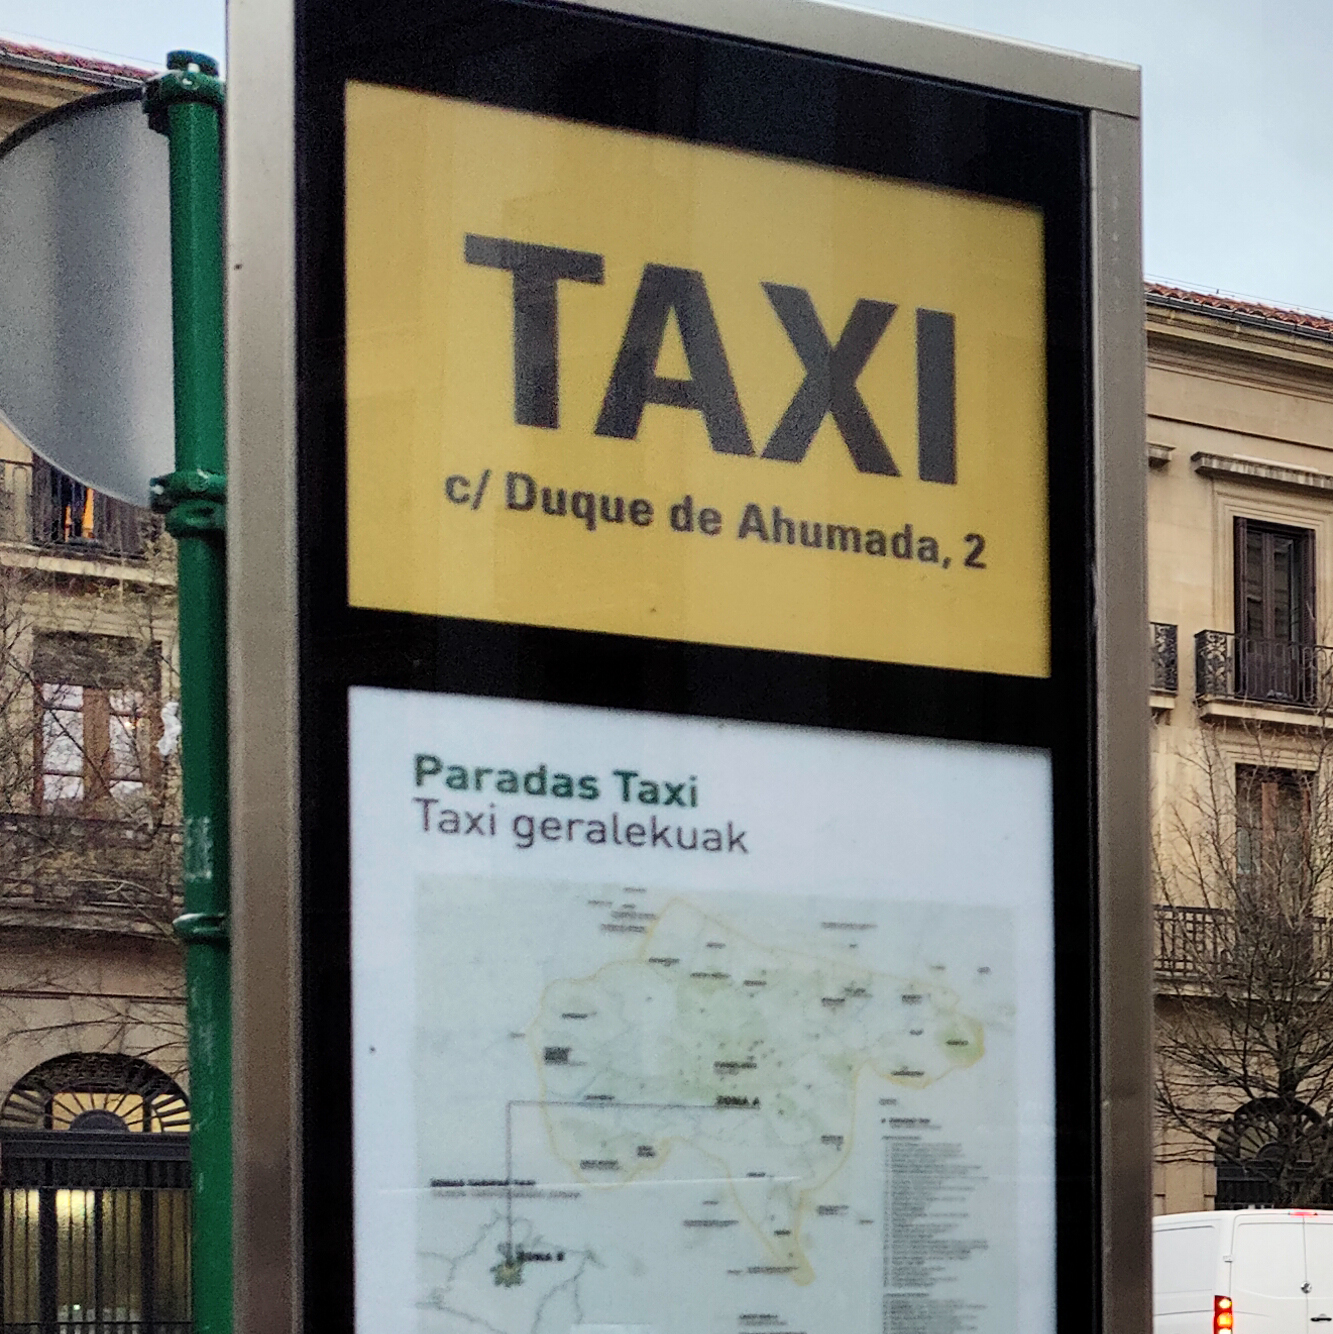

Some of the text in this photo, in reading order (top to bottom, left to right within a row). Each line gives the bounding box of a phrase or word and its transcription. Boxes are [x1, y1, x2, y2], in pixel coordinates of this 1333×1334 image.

[462, 232, 958, 486] TAXI
[444, 468, 987, 570] c/ Duque de Ahumada, 2
[414, 753, 700, 808] Paradas Taxi
[414, 797, 750, 856] Taxi geralekuak
